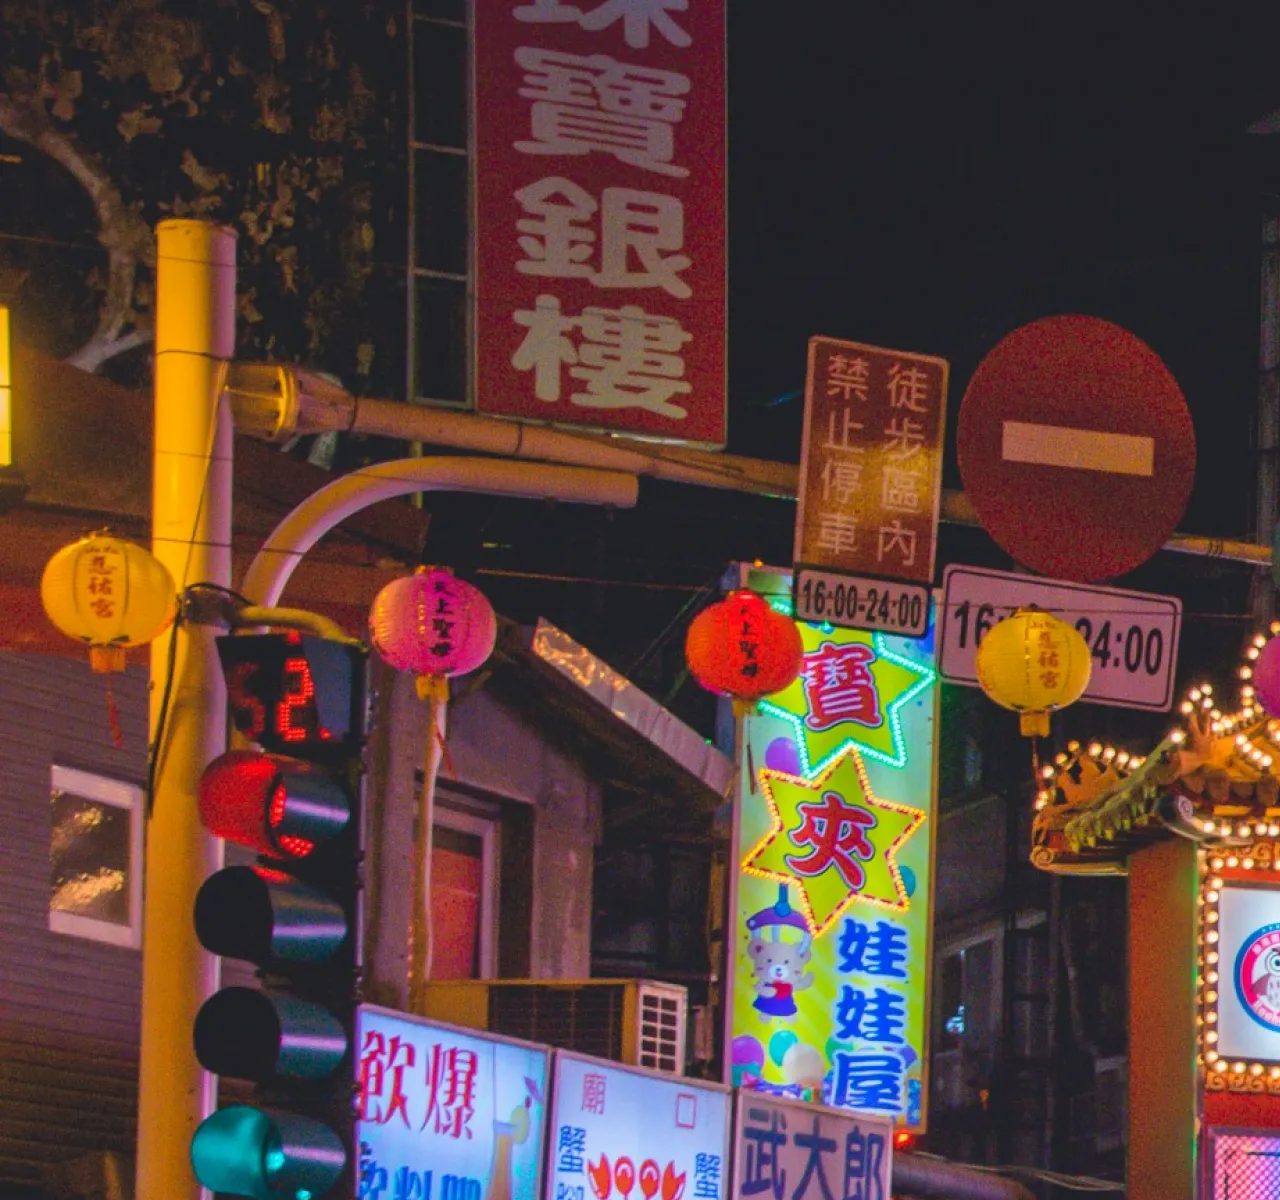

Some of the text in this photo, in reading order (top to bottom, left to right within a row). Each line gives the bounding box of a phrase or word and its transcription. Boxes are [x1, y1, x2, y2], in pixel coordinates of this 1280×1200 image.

[815, 354, 870, 557] 禁止停車
[877, 362, 930, 567] 徒步區內
[802, 578, 924, 631] 16:00-24:00
[358, 1028, 479, 1140] 飲爆
[833, 918, 909, 1112] 娃娃屋
